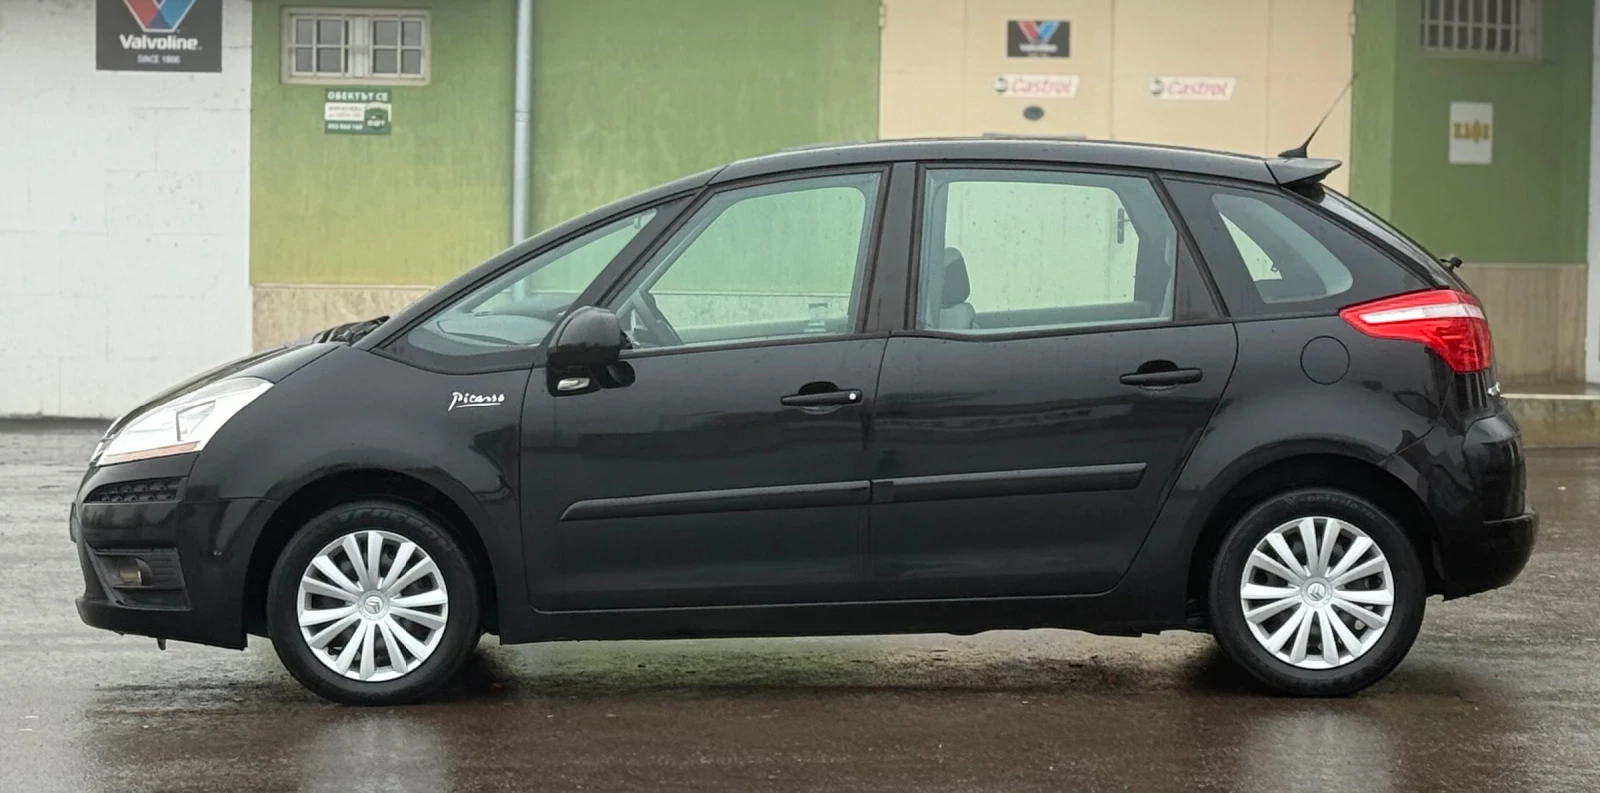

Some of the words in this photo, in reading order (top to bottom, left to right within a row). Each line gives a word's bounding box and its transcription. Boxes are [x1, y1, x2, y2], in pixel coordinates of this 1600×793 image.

[119, 34, 198, 50] Valvoline
[137, 54, 160, 64] SINCE
[1012, 78, 1072, 93] Castrol
[1167, 80, 1228, 96] Castrol
[327, 91, 374, 101] ОБЕКТЪТ
[375, 92, 389, 101] СЕ
[448, 390, 506, 412] Picasso
